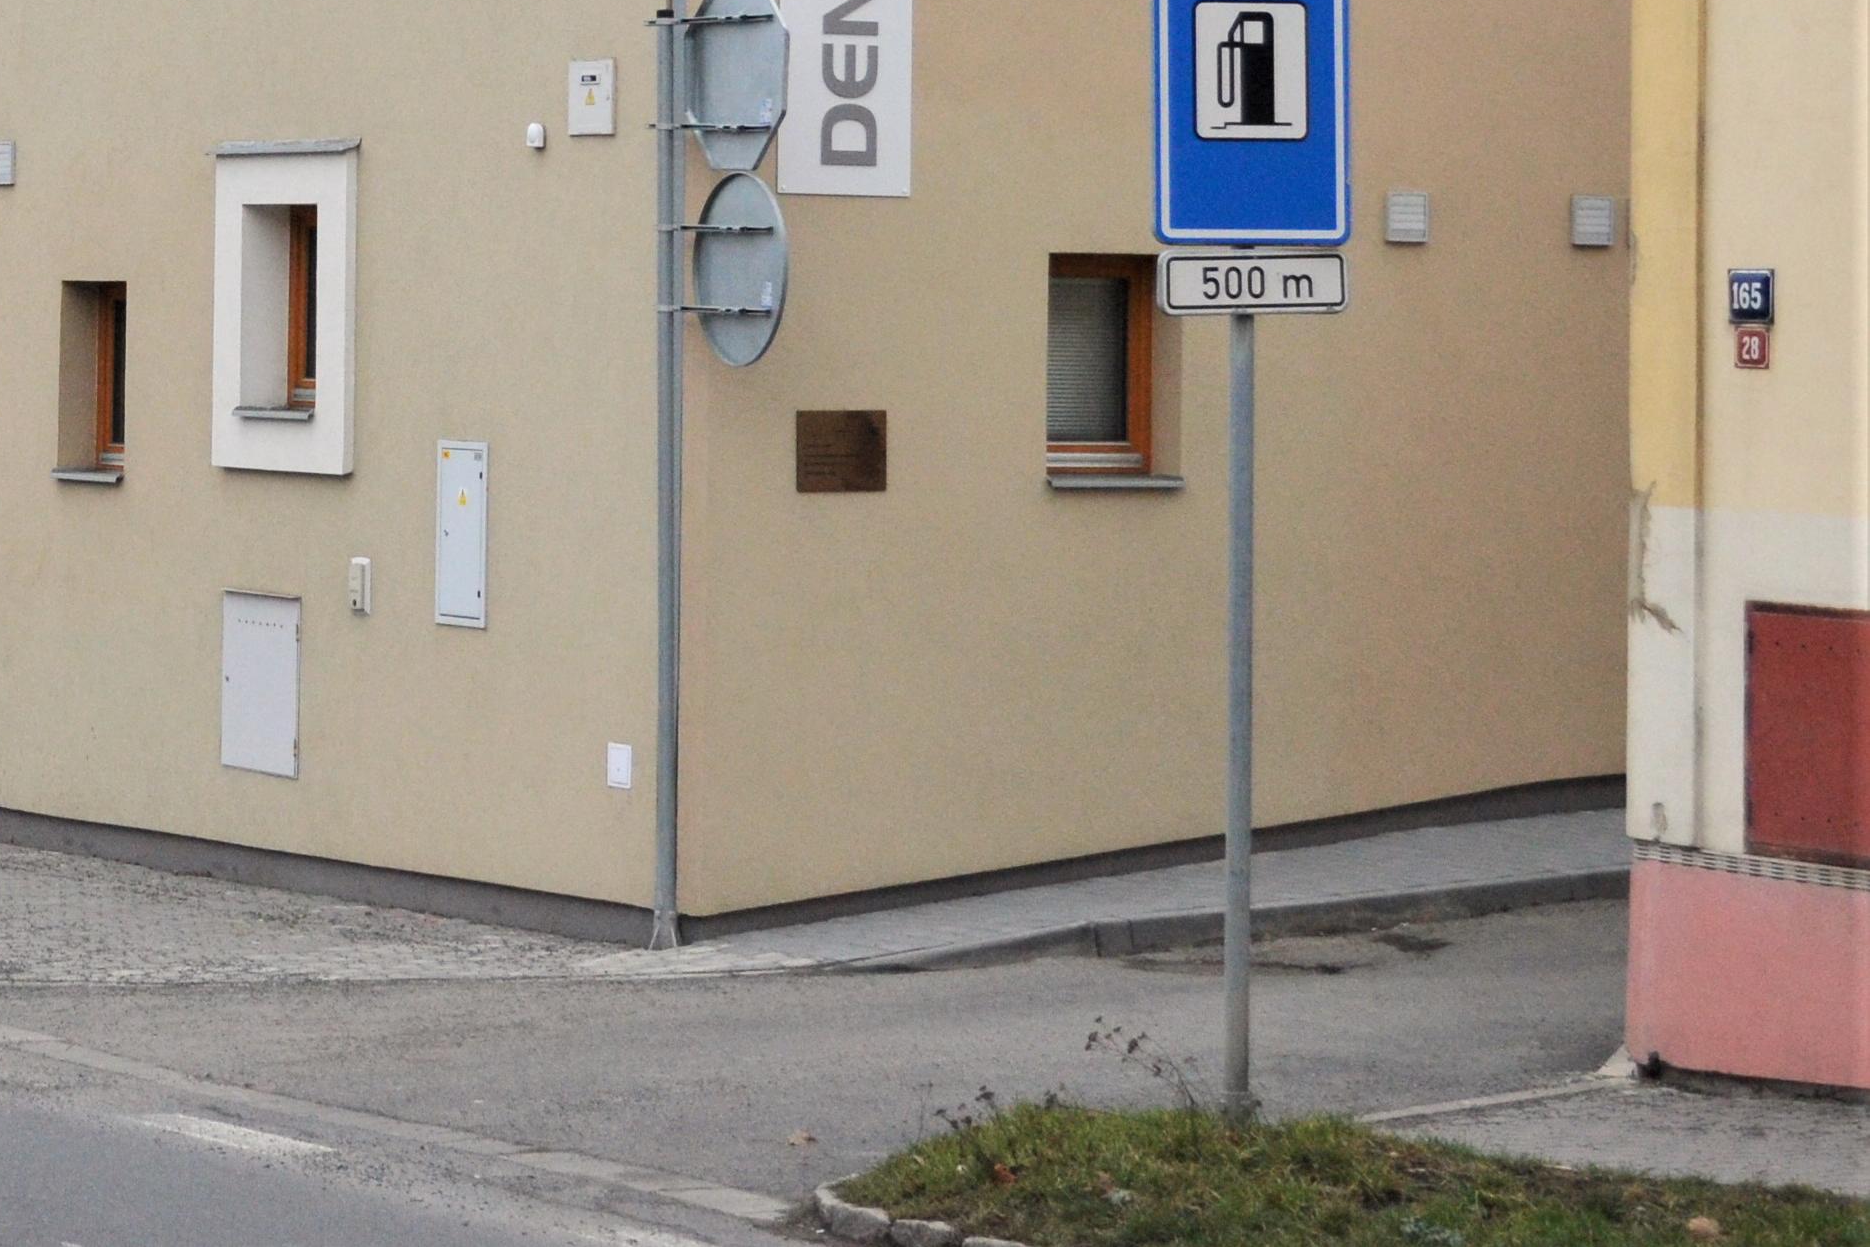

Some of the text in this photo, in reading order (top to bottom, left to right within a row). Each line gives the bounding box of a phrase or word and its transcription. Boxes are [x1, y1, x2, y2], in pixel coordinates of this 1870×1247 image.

[1202, 266, 1313, 299] 500 m
[1732, 282, 1762, 310] 165
[1742, 336, 1760, 360] 28
